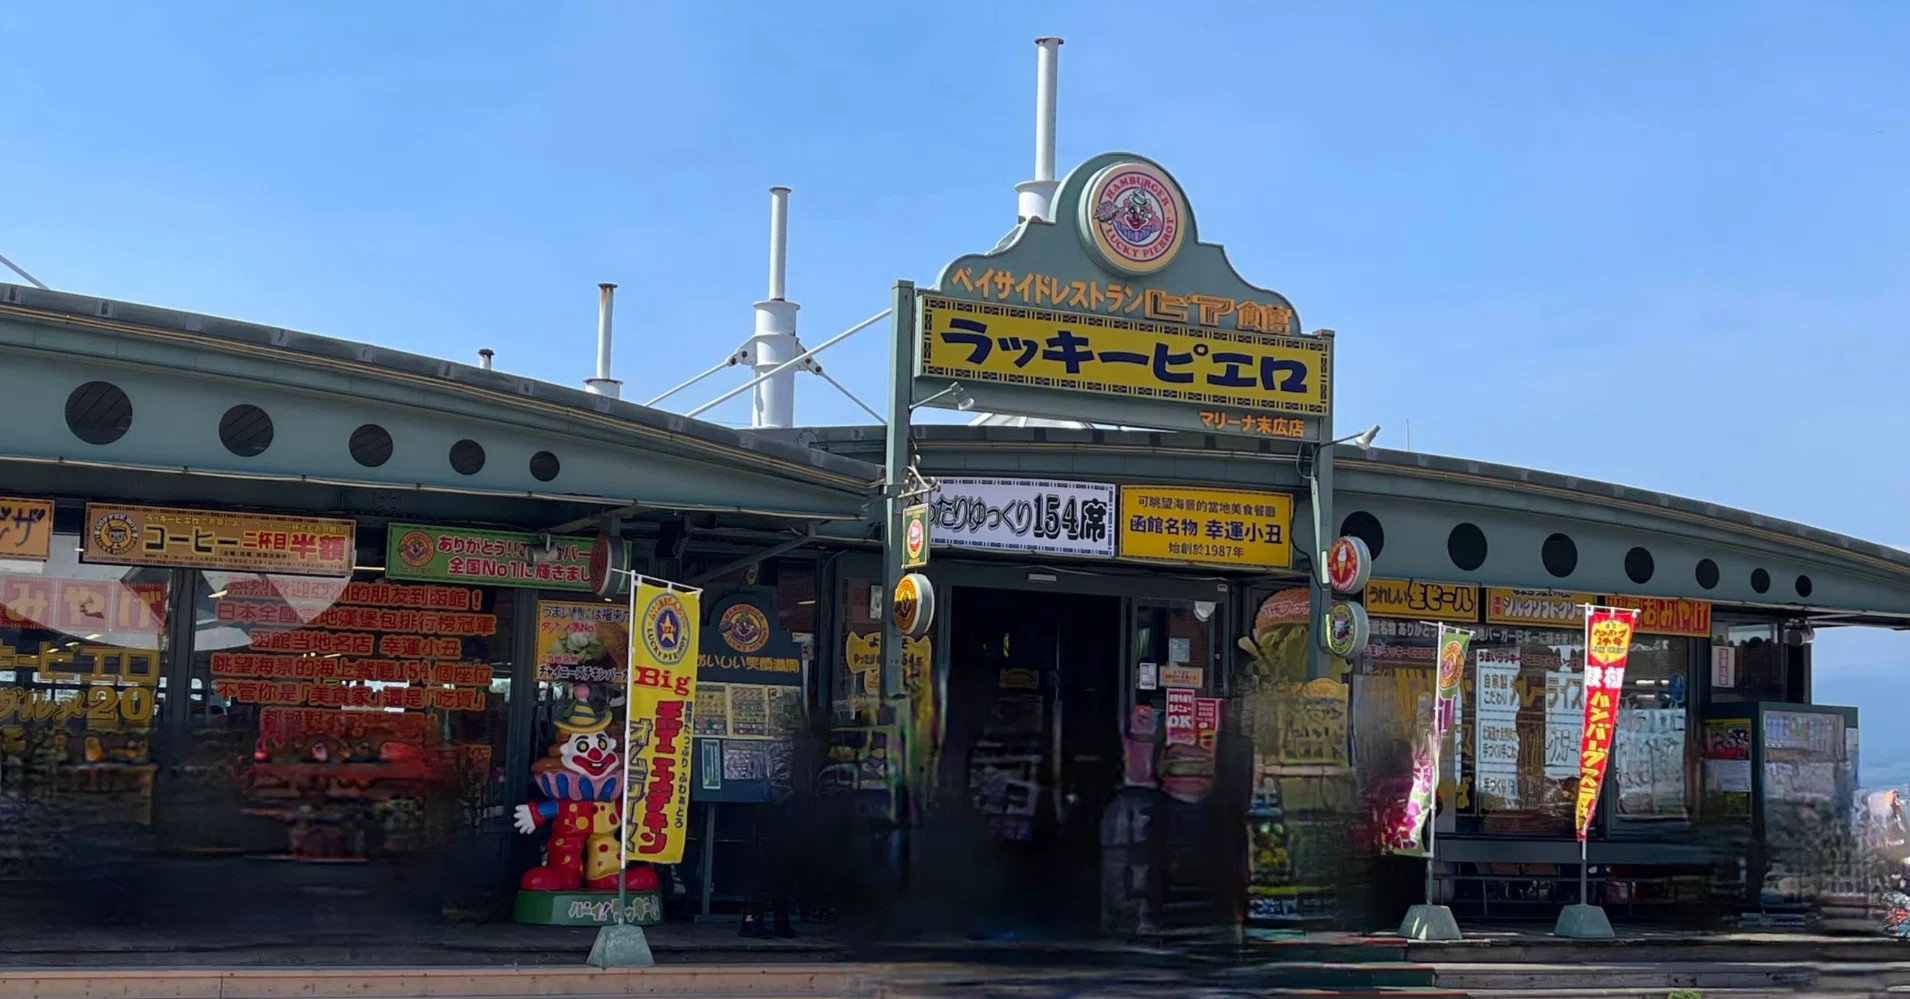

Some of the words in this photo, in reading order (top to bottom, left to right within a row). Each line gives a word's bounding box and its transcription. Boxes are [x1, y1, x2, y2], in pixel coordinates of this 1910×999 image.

[1106, 175, 1170, 207] HAMBURGER
[1105, 228, 1138, 258] LUCKY
[1142, 216, 1174, 258] PIERROT
[952, 267, 1145, 314] ベイサイドレストラン
[940, 317, 1307, 394] ラッキーピエロ
[1199, 411, 1304, 438] マリーナ末広店
[1203, 518, 1283, 545] 幸運小丑
[634, 665, 692, 696] Big
[1166, 714, 1193, 729] OK
